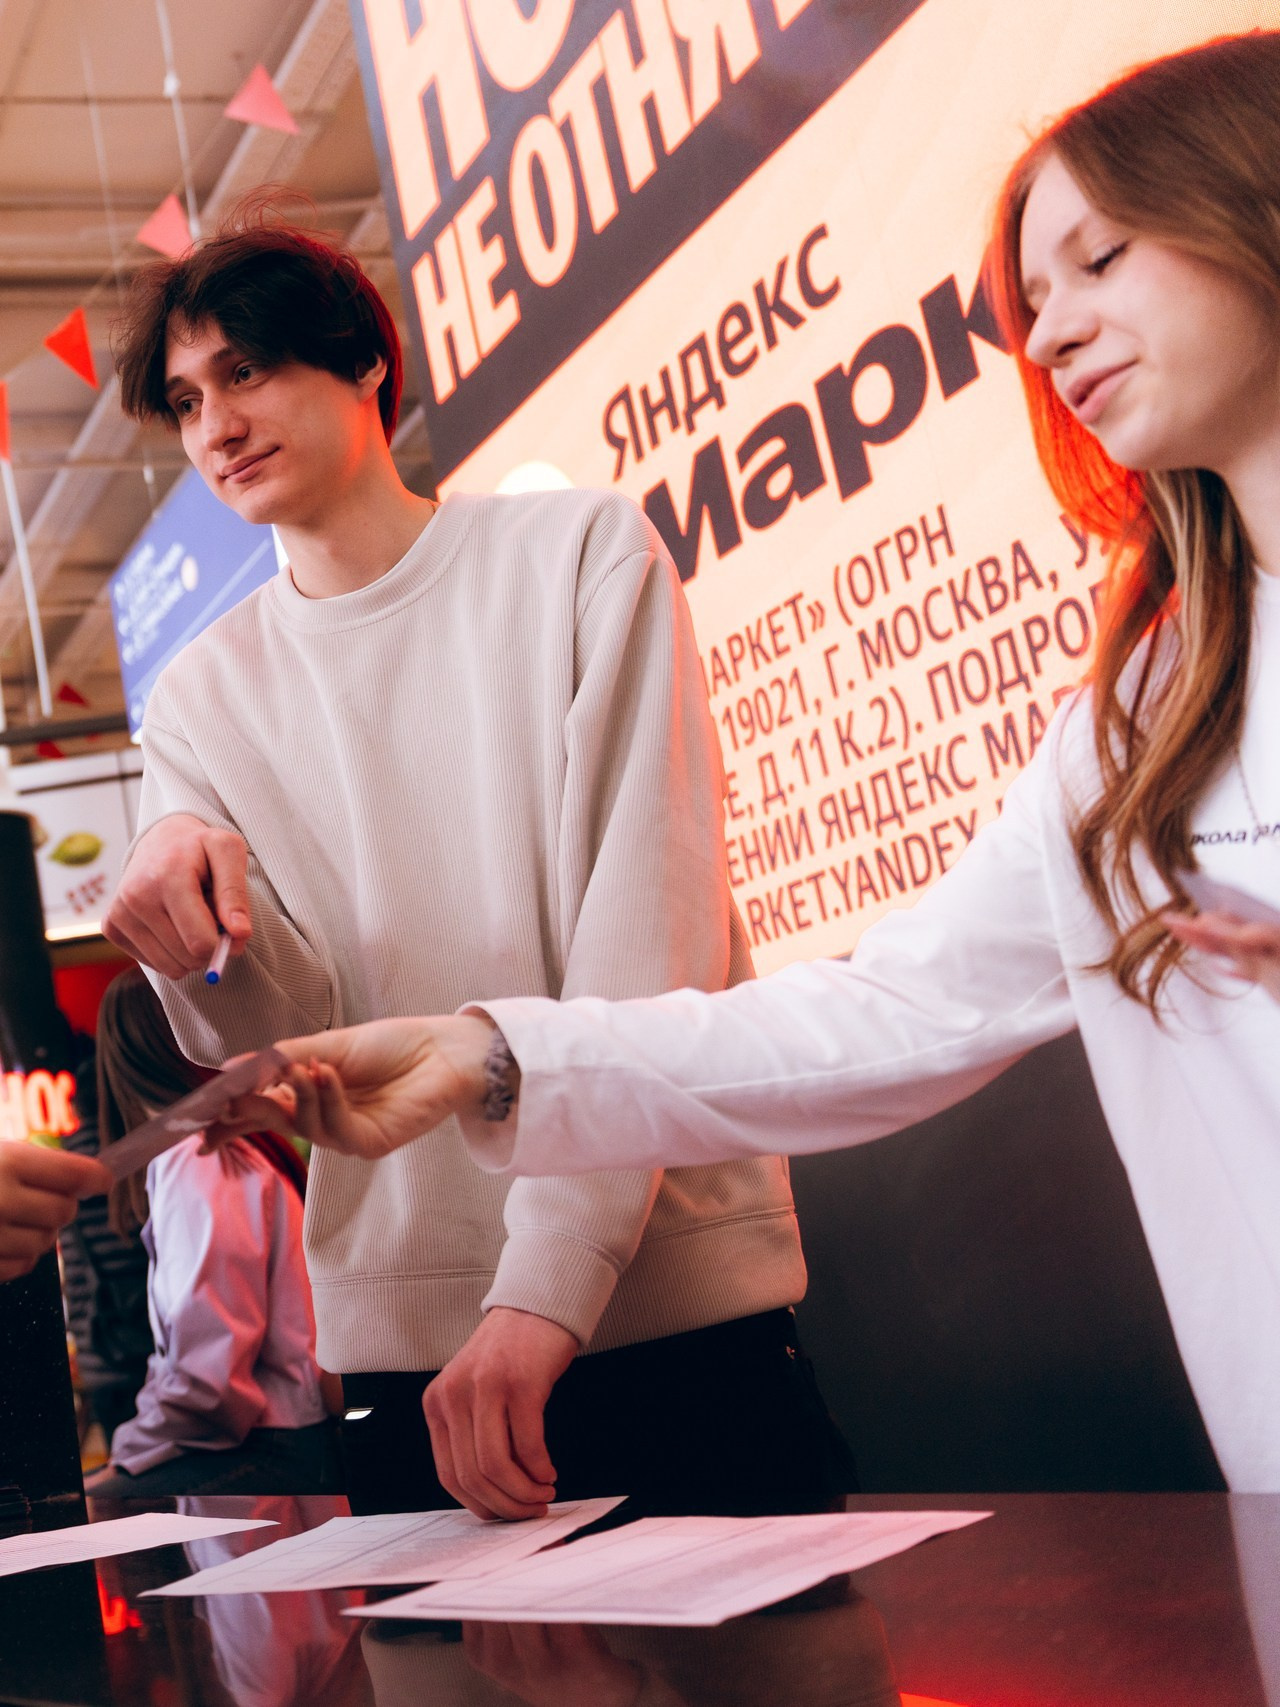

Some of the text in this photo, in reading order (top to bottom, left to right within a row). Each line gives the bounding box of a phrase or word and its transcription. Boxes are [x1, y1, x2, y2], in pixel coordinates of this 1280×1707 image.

[411, 0, 817, 405] НЕ ОТНЯ
[602, 222, 842, 483] Яндекс
[699, 502, 956, 699] АРКЕТ» (ОГРН
[757, 728, 830, 816] Д.11
[833, 685, 925, 768] К.2).
[926, 577, 1114, 723] ПОДРО
[823, 643, 856, 700] Г.
[857, 539, 1060, 681] МОСКВА,
[818, 734, 979, 850] ЯНДЕКС
[980, 684, 1074, 780] МА
